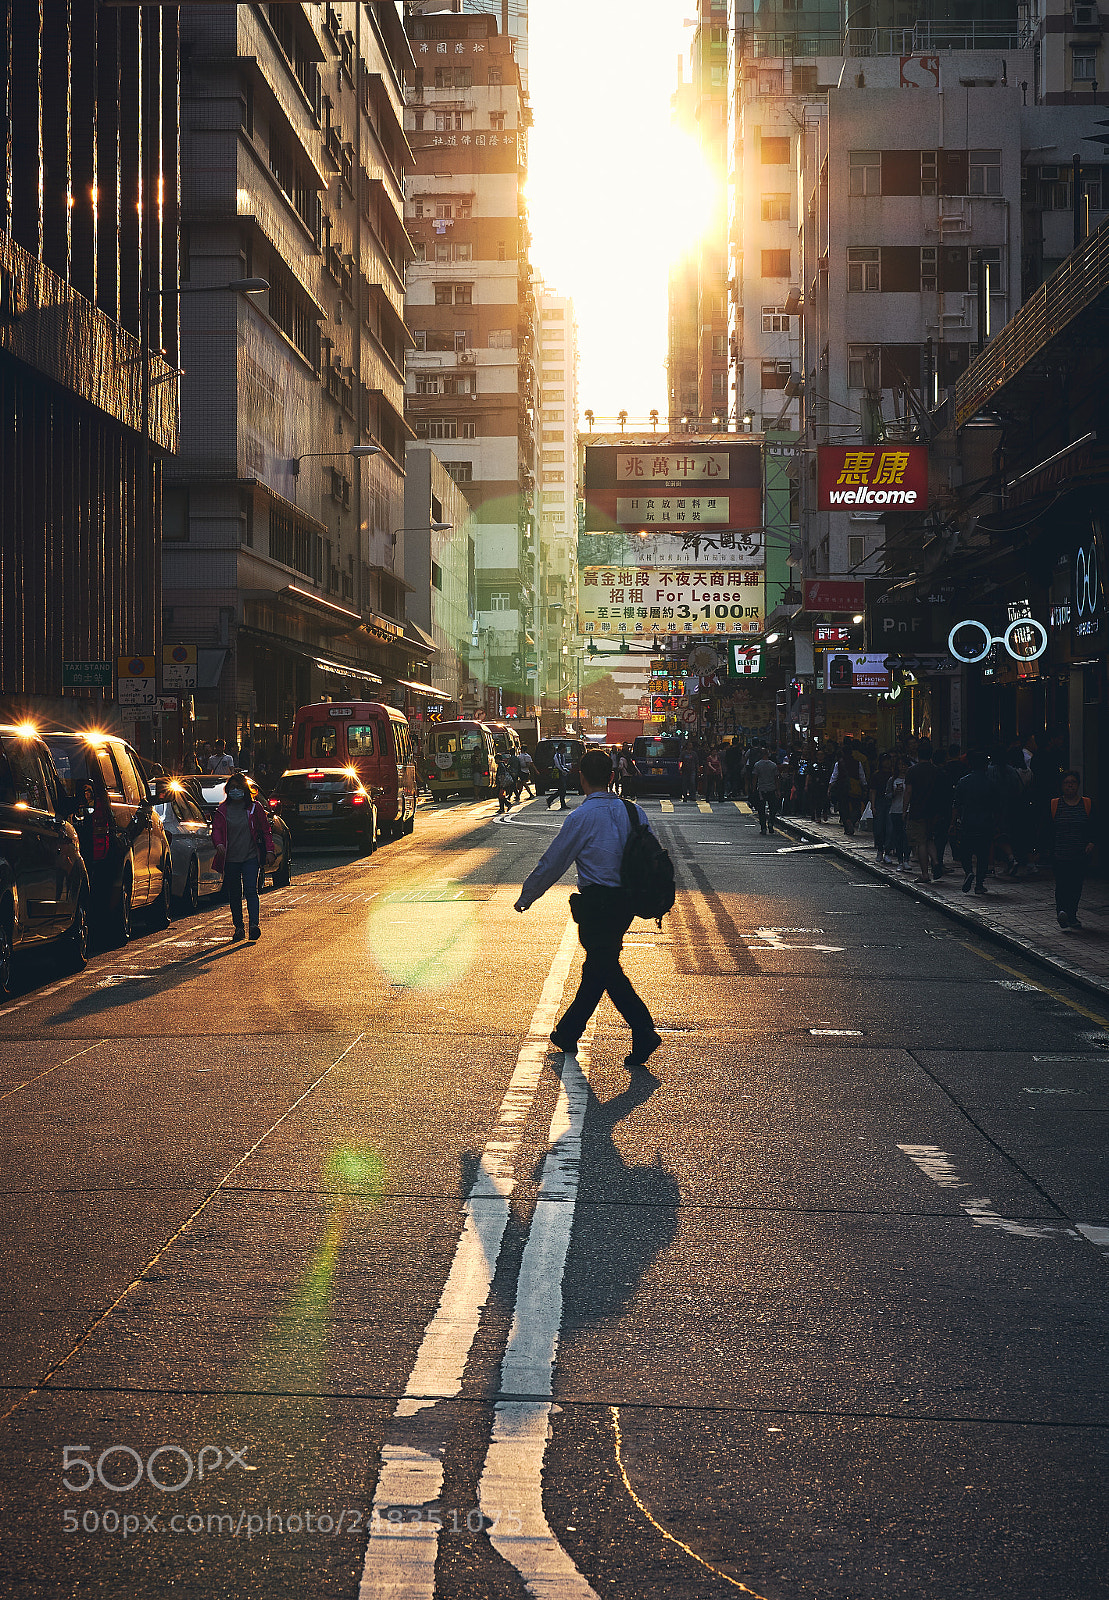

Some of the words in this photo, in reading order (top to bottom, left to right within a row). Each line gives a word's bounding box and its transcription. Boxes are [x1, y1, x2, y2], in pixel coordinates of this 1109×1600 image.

[625, 456, 722, 477] 兆萬中心
[836, 451, 910, 485] 惠康
[829, 486, 917, 504] wellcome
[646, 511, 701, 521] 玩具時裝
[583, 572, 650, 587] 黃金地段
[609, 588, 644, 604] 招租
[656, 589, 684, 602] For
[691, 589, 741, 602] Lease
[184, 666, 191, 674] 7
[73, 673, 104, 683] 的士站
[185, 678, 195, 688] 12
[141, 679, 149, 689] 7
[142, 694, 154, 703] 12
